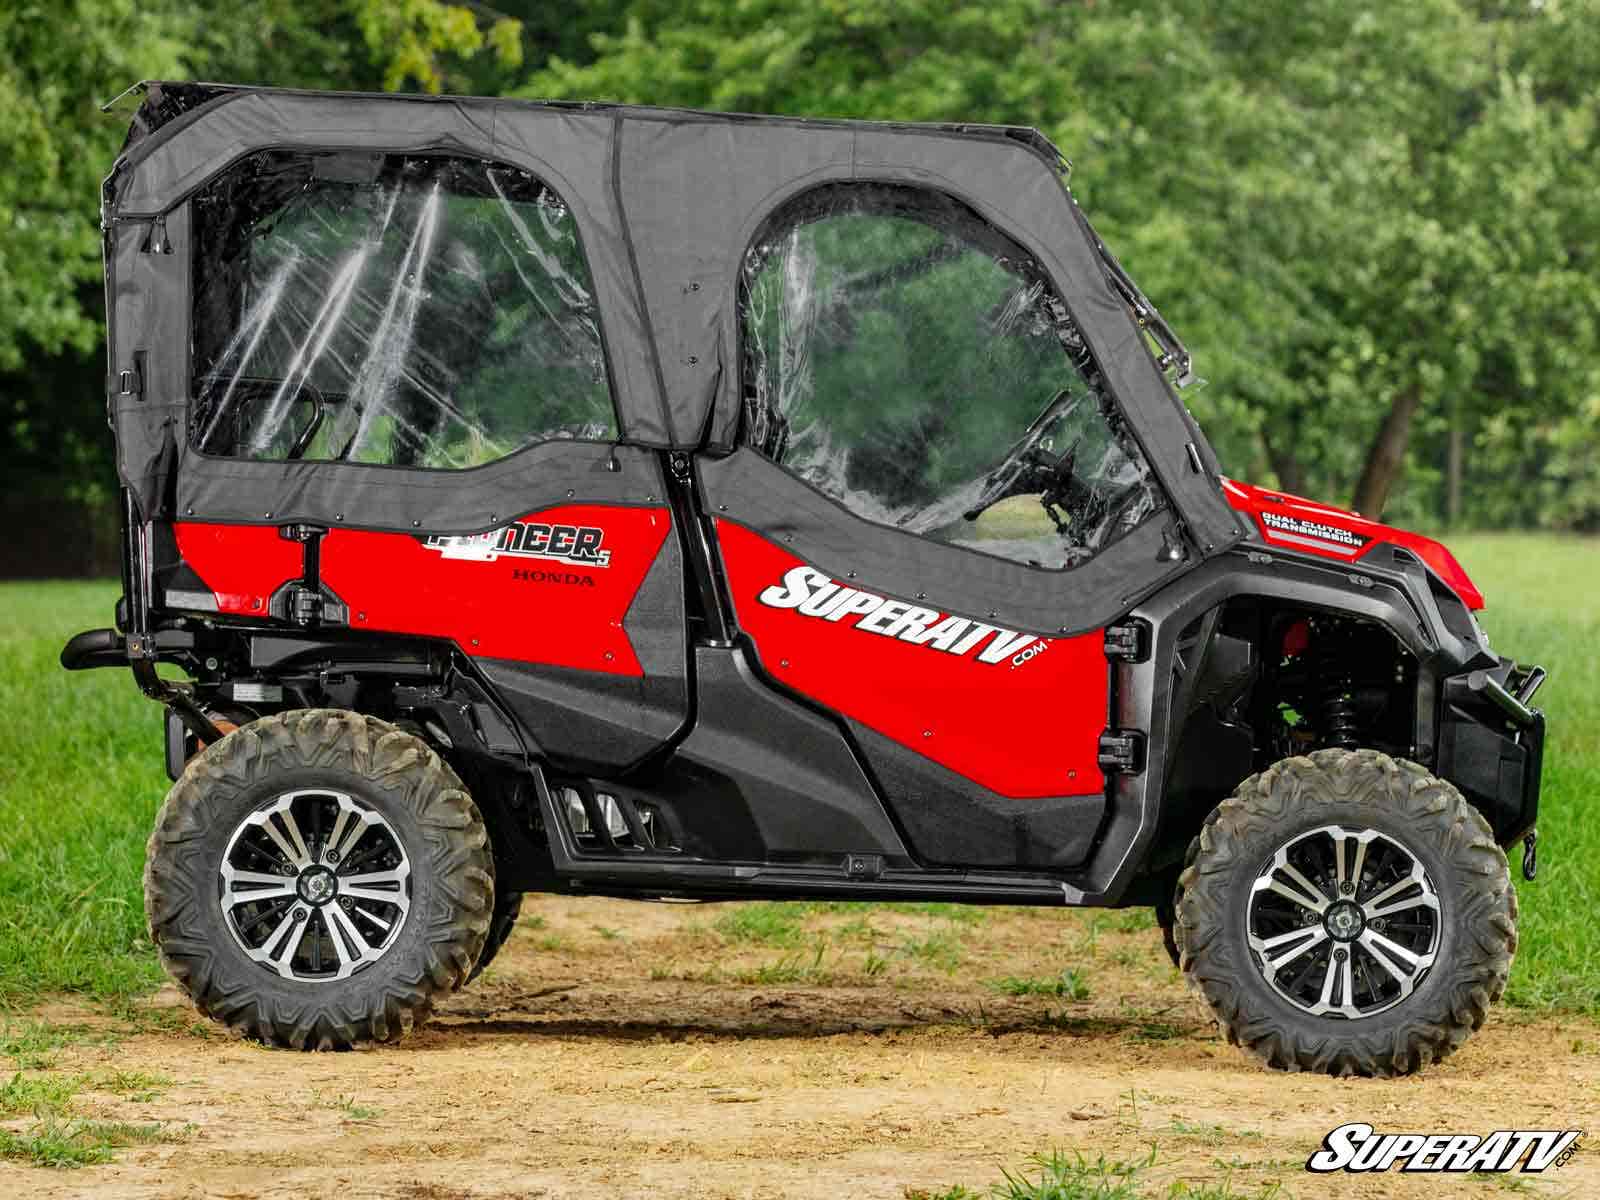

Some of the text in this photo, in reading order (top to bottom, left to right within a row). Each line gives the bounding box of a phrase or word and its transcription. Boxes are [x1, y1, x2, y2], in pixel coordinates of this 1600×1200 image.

[1262, 512, 1352, 537] DUAL CLUTCH
[1264, 518, 1364, 547] TRANSMISSION
[511, 568, 595, 587] HONDA
